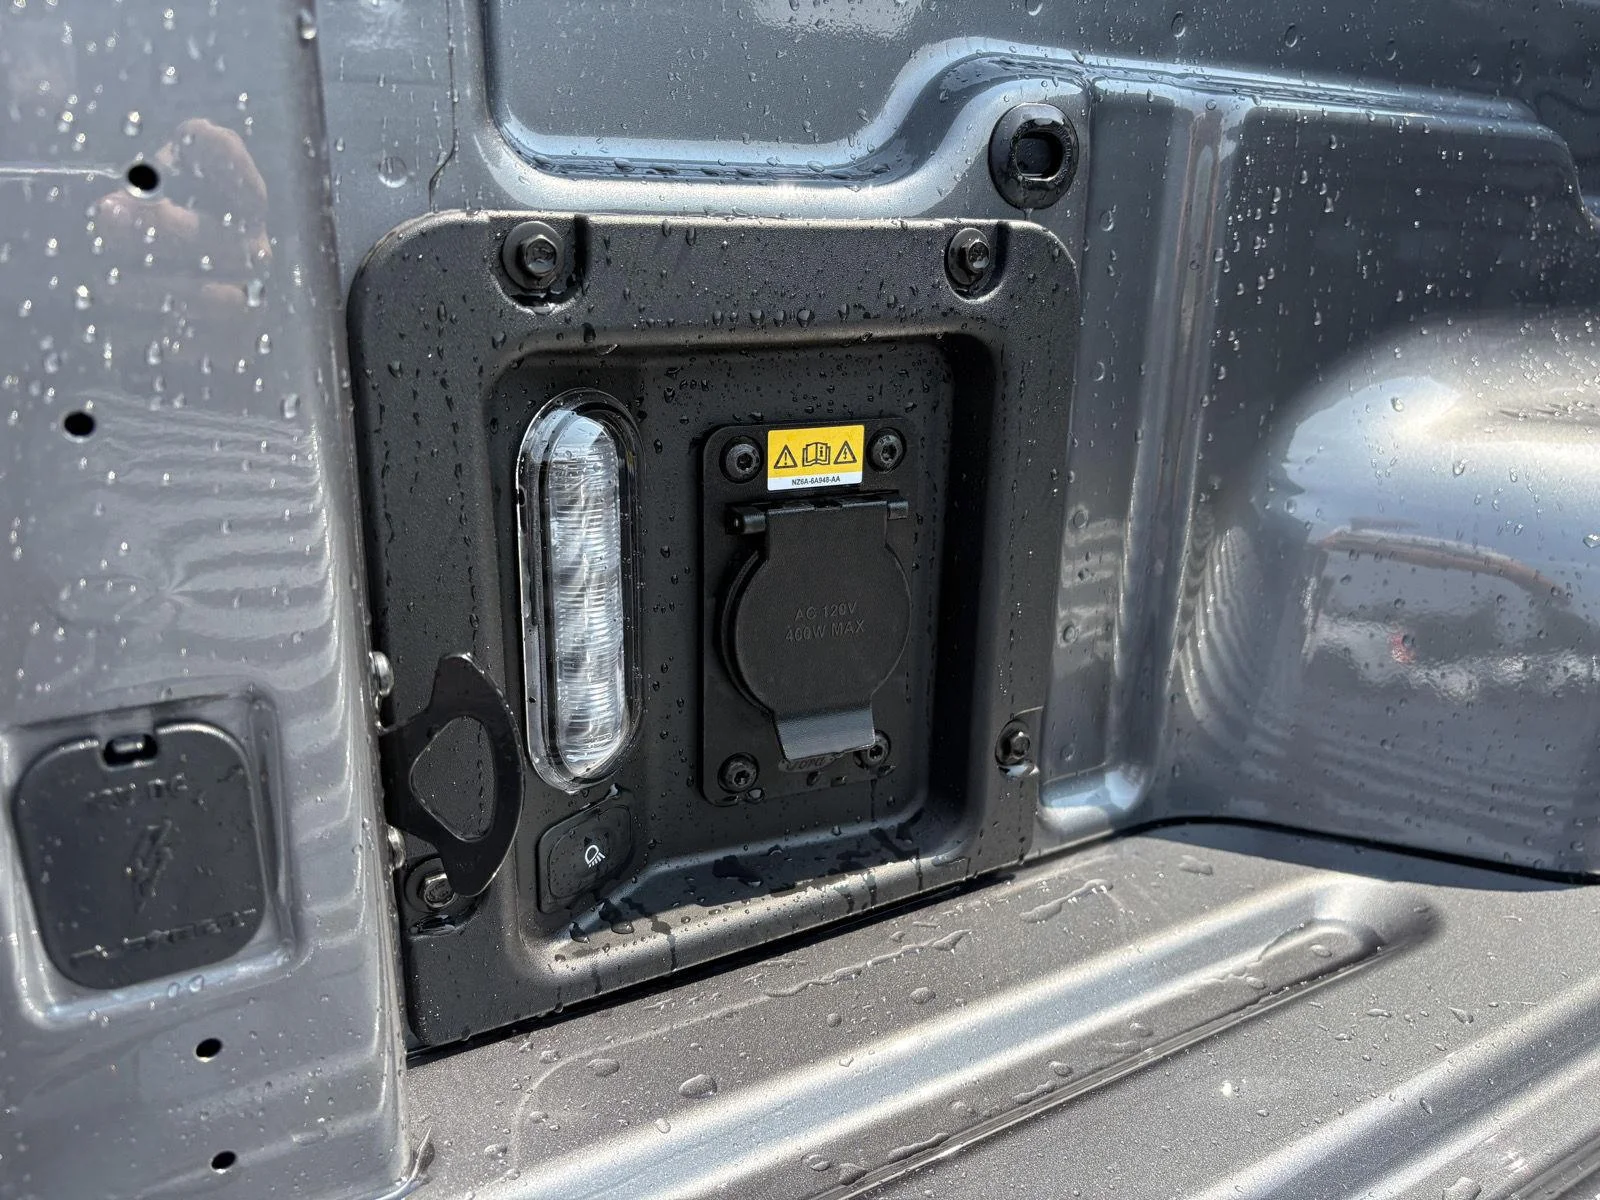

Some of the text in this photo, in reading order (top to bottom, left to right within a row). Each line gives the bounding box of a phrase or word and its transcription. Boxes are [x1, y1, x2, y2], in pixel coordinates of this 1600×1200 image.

[794, 600, 857, 621] AC 120V
[785, 619, 865, 641] 400W MAX
